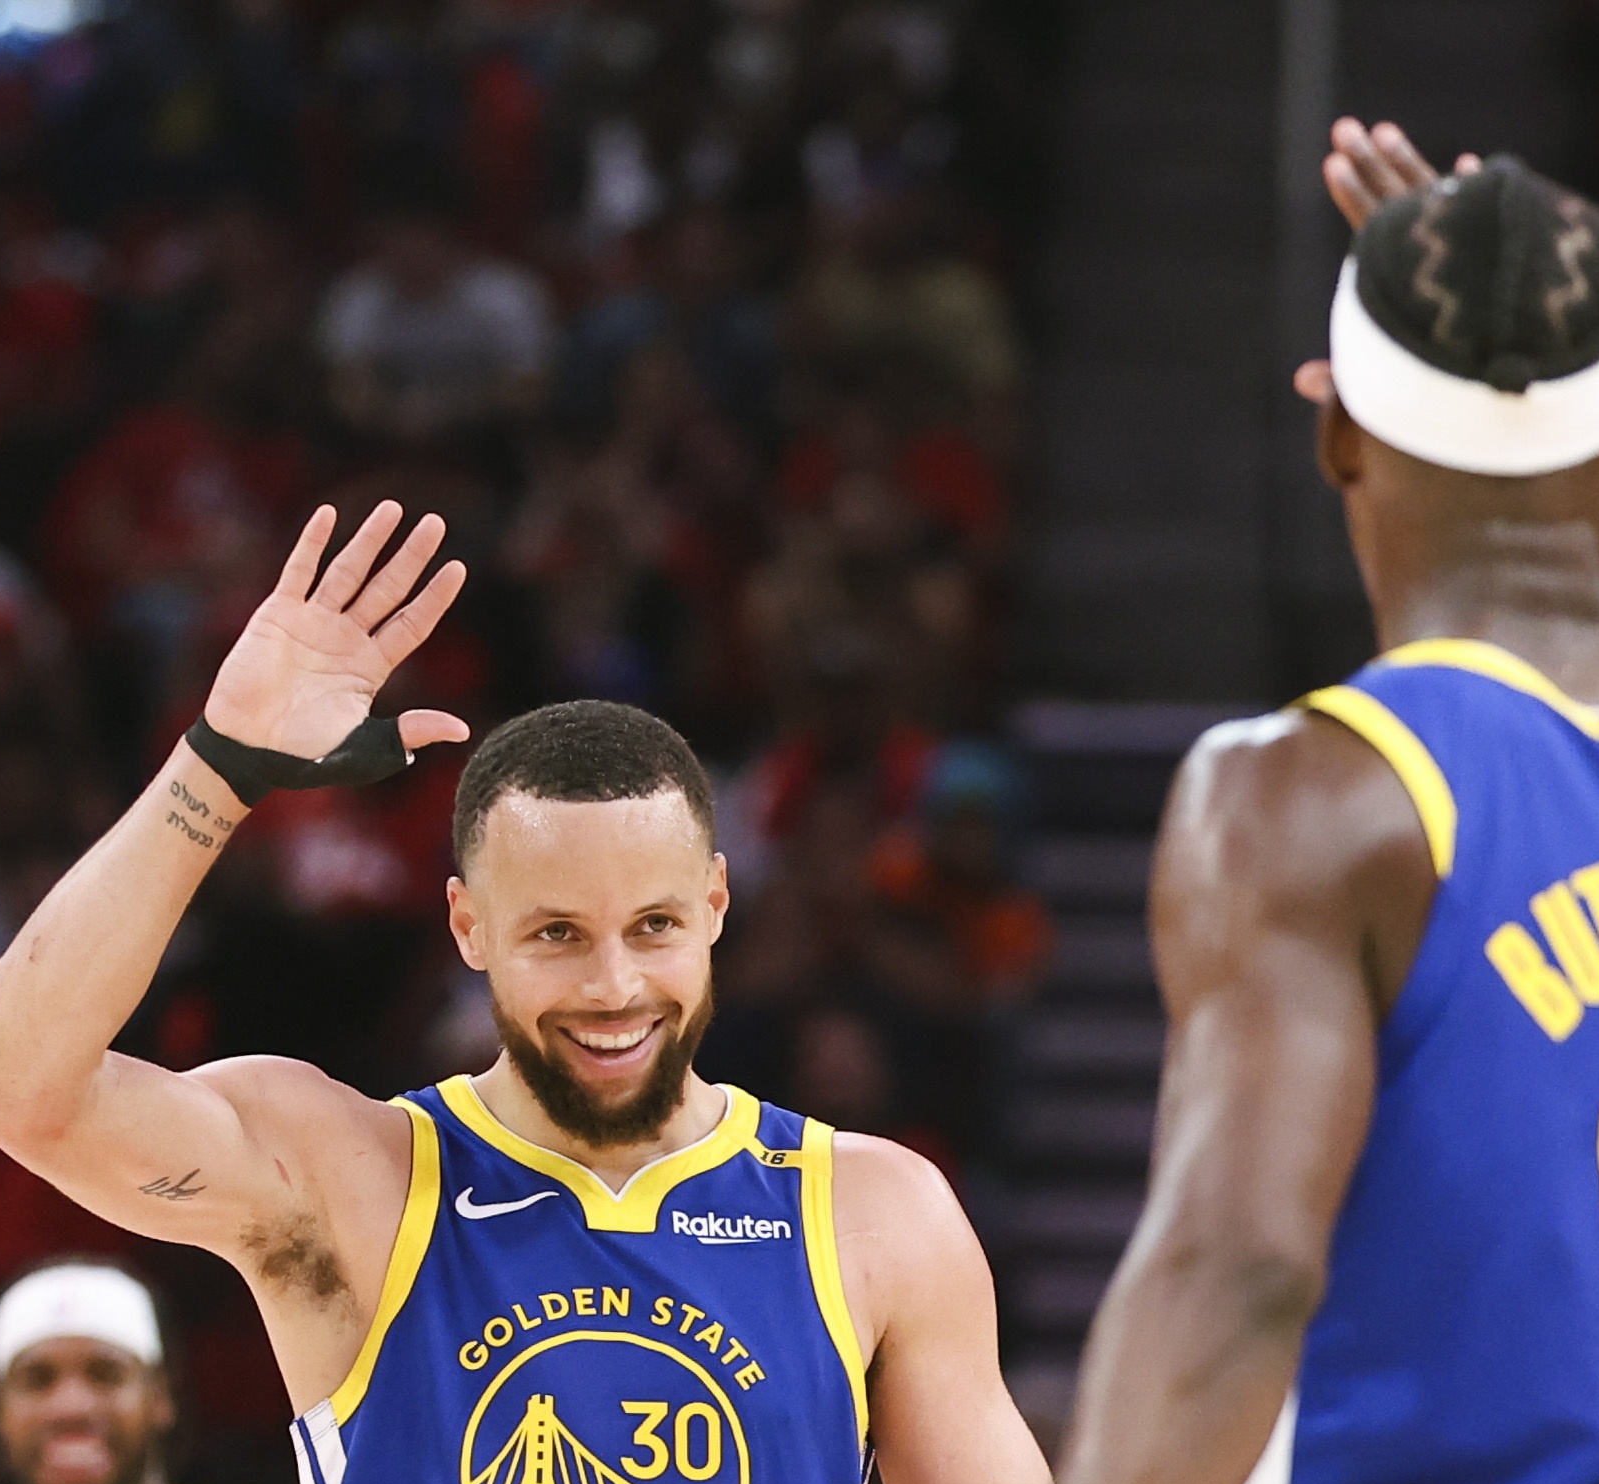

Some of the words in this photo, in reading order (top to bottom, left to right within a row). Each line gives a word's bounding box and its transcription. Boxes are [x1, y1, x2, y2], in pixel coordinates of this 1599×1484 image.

[760, 1150, 787, 1165] 16
[671, 1210, 792, 1240] Rakuten
[458, 1286, 631, 1370] GOLDEN
[650, 1296, 766, 1391] STATE
[620, 1400, 722, 1482] 30
